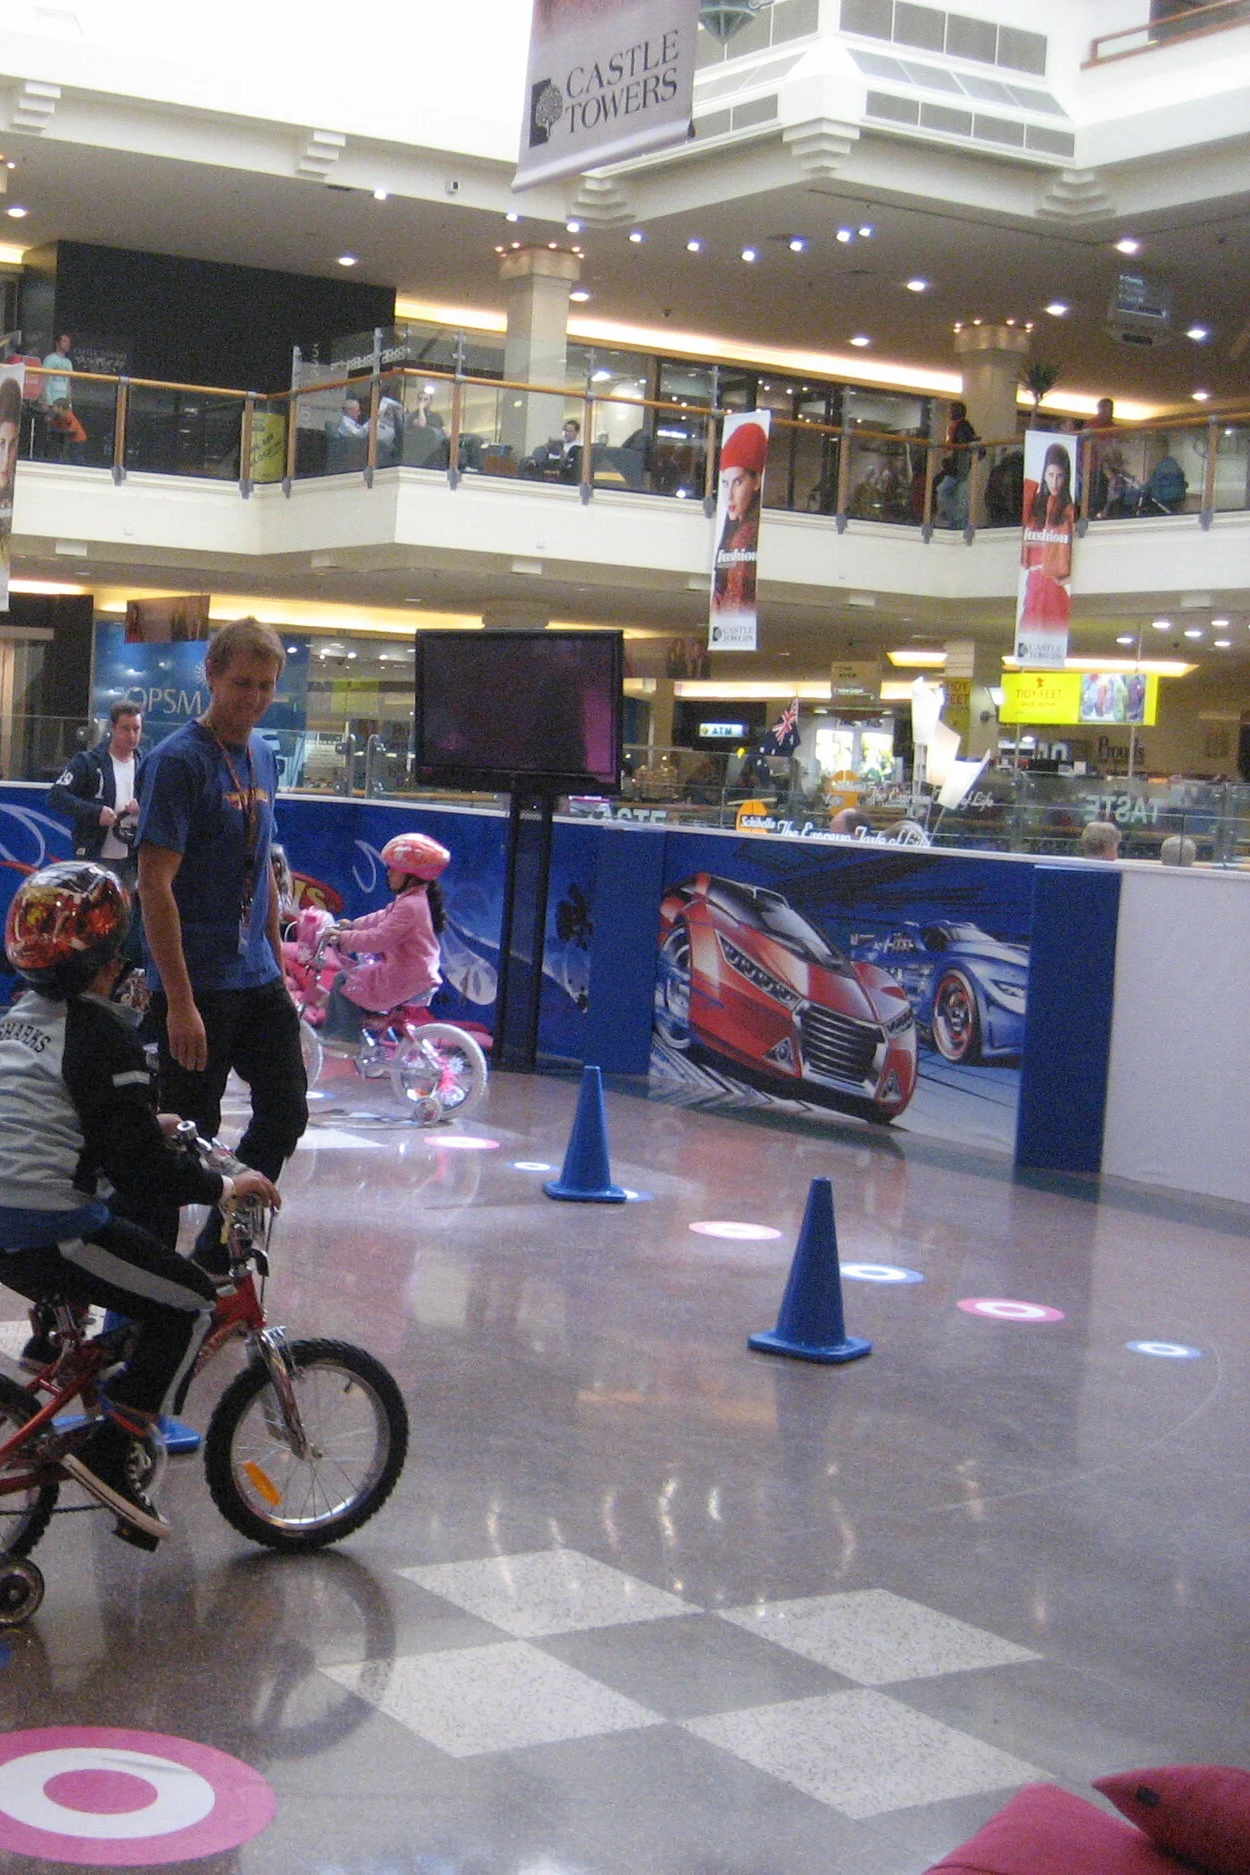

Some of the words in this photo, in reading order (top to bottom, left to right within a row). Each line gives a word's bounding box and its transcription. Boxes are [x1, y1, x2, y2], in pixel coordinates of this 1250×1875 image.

[566, 30, 680, 98] CASTLE
[565, 68, 678, 133] TOWERS
[125, 687, 201, 715] OPSM
[1039, 689, 1062, 699] FEET
[711, 726, 733, 735] ATM
